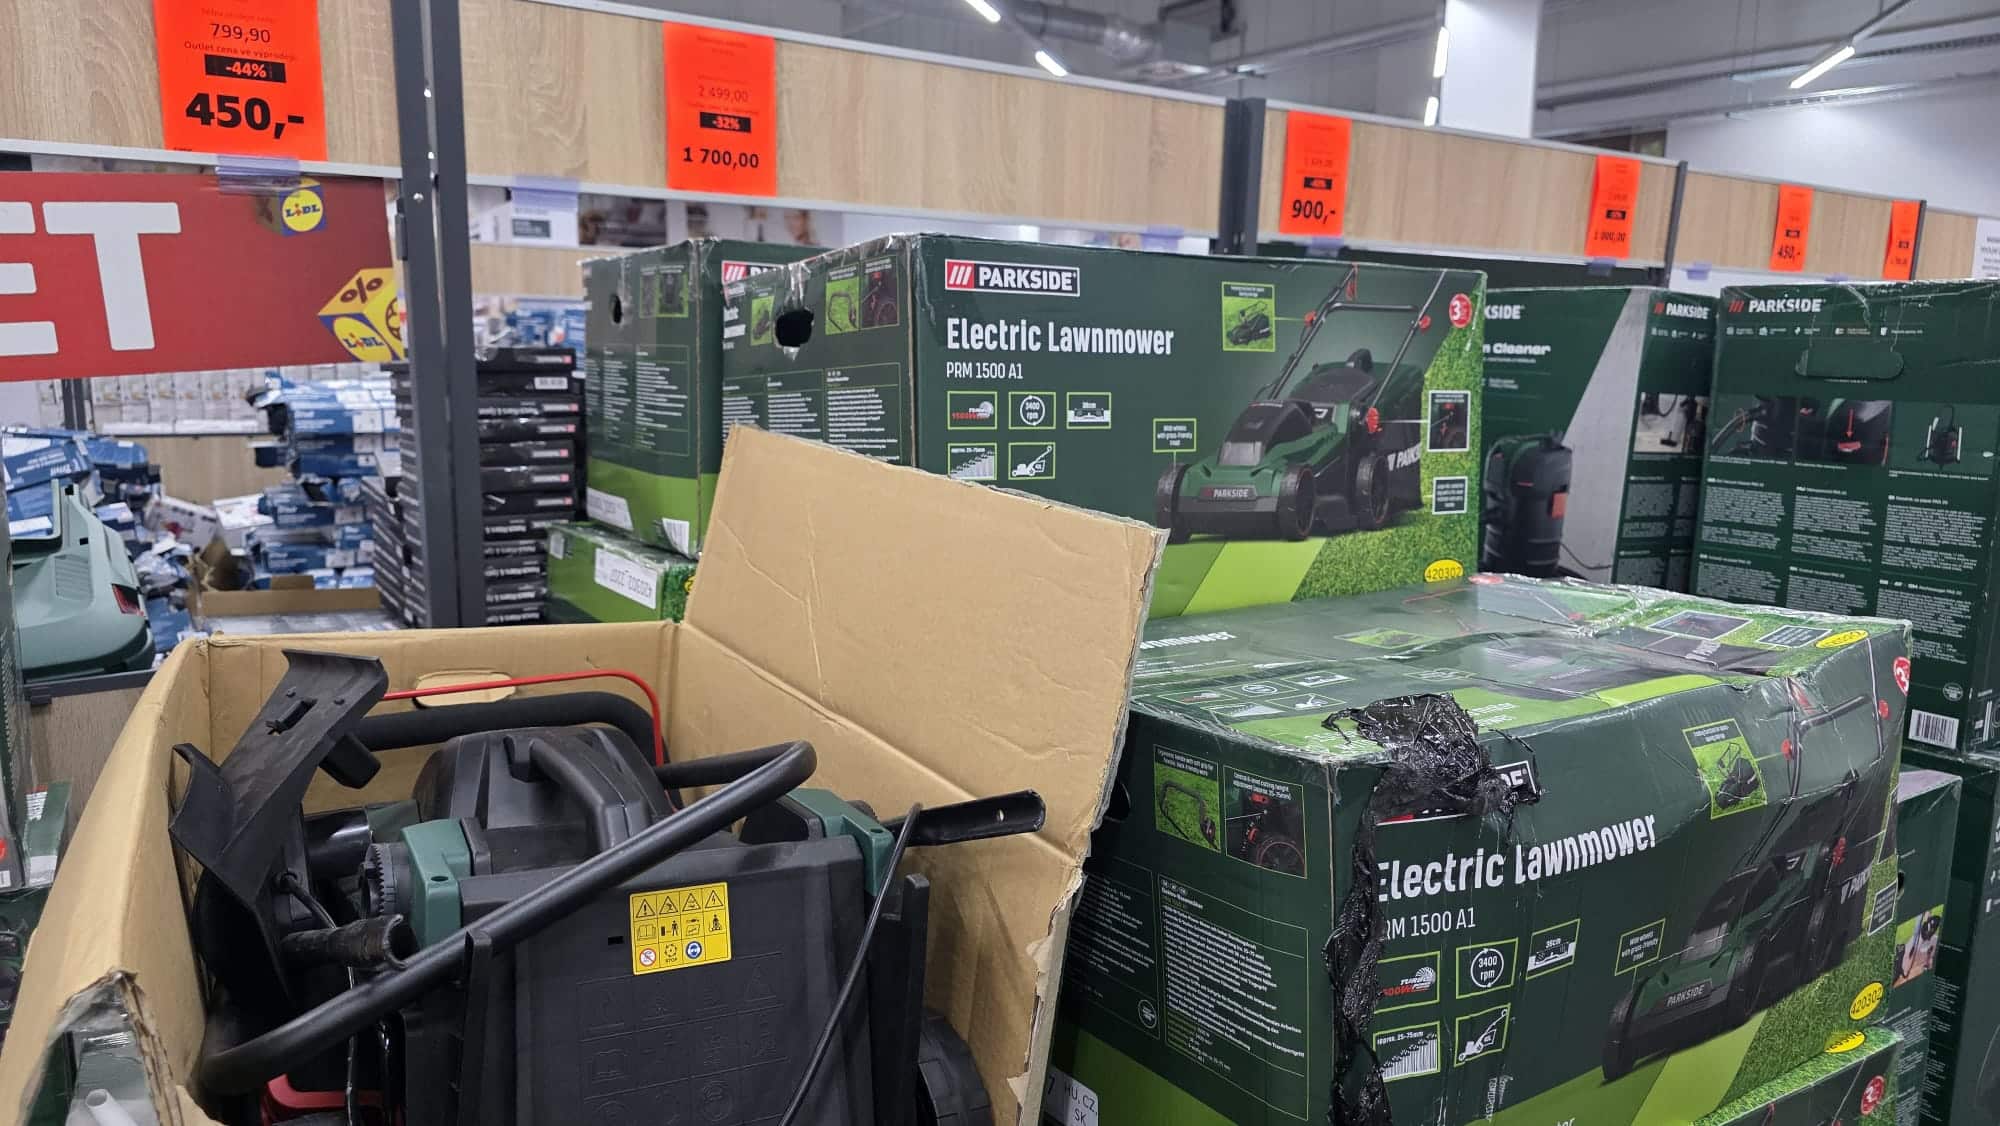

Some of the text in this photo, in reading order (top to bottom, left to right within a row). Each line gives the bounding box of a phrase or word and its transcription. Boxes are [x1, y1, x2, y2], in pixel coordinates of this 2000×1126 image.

[210, 24, 270, 43] 799,90
[184, 41, 214, 51] Outlet
[225, 62, 267, 78] -44%
[185, 92, 304, 139] 450,-
[700, 148, 759, 169] 700,00
[1291, 199, 1336, 224] 900,-
[978, 266, 1073, 291] PARKSIDE
[1452, 300, 1461, 321] 3
[1666, 302, 1709, 320] PARKSIDE
[1748, 299, 1821, 313] PARKSIDE
[947, 317, 1175, 355] Electric Lawnmower
[946, 361, 1023, 379] PRM 1500 A1
[1378, 814, 1656, 903] Electric Lawnmower
[1411, 911, 1451, 938] 1500
[1456, 907, 1476, 930] A1
[1478, 955, 1498, 968] 3400
[1480, 969, 1496, 982] rpm
[1666, 984, 1705, 1007] PARKSIDE
[1851, 987, 1882, 1015] 420302
[1074, 1108, 1087, 1126] SK
